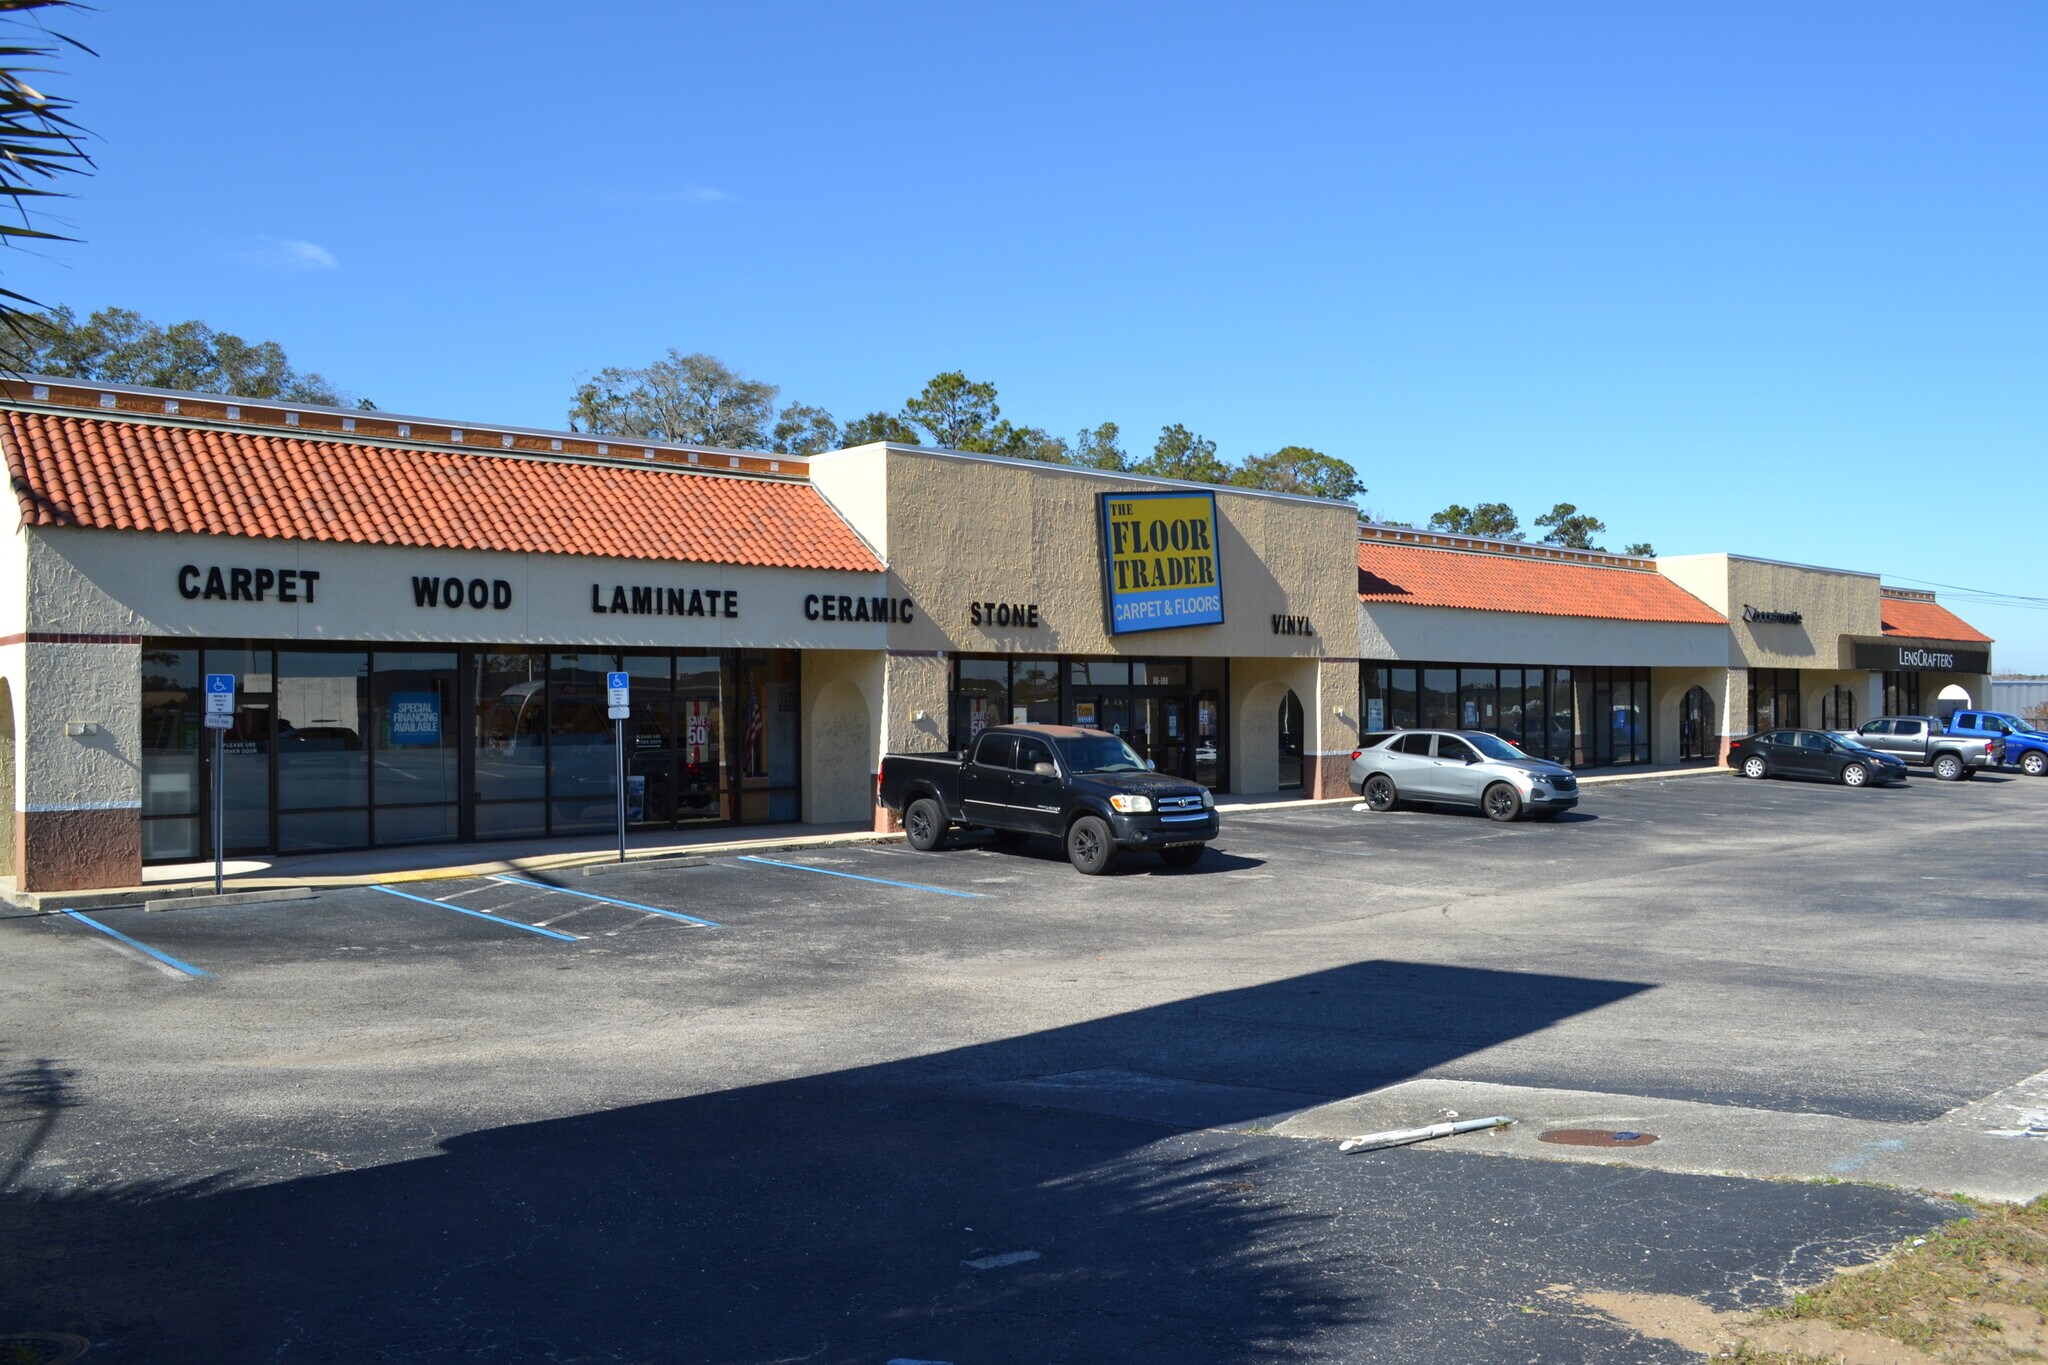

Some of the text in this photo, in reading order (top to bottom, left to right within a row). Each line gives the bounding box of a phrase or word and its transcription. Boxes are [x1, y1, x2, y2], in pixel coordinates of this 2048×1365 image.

[1110, 503, 1133, 516] THE
[1112, 518, 1210, 555] FLOOR
[1113, 556, 1215, 589] TRADER
[178, 564, 1313, 636] CARPET WOOD LAMINATE CERAMIC STONE VINYL
[1115, 595, 1220, 621] CARPET & FLOORS
[398, 702, 433, 713] SPECIAL
[393, 712, 438, 723] FINANCING
[687, 715, 706, 726] SAVE
[393, 722, 438, 733] AVAILABLE
